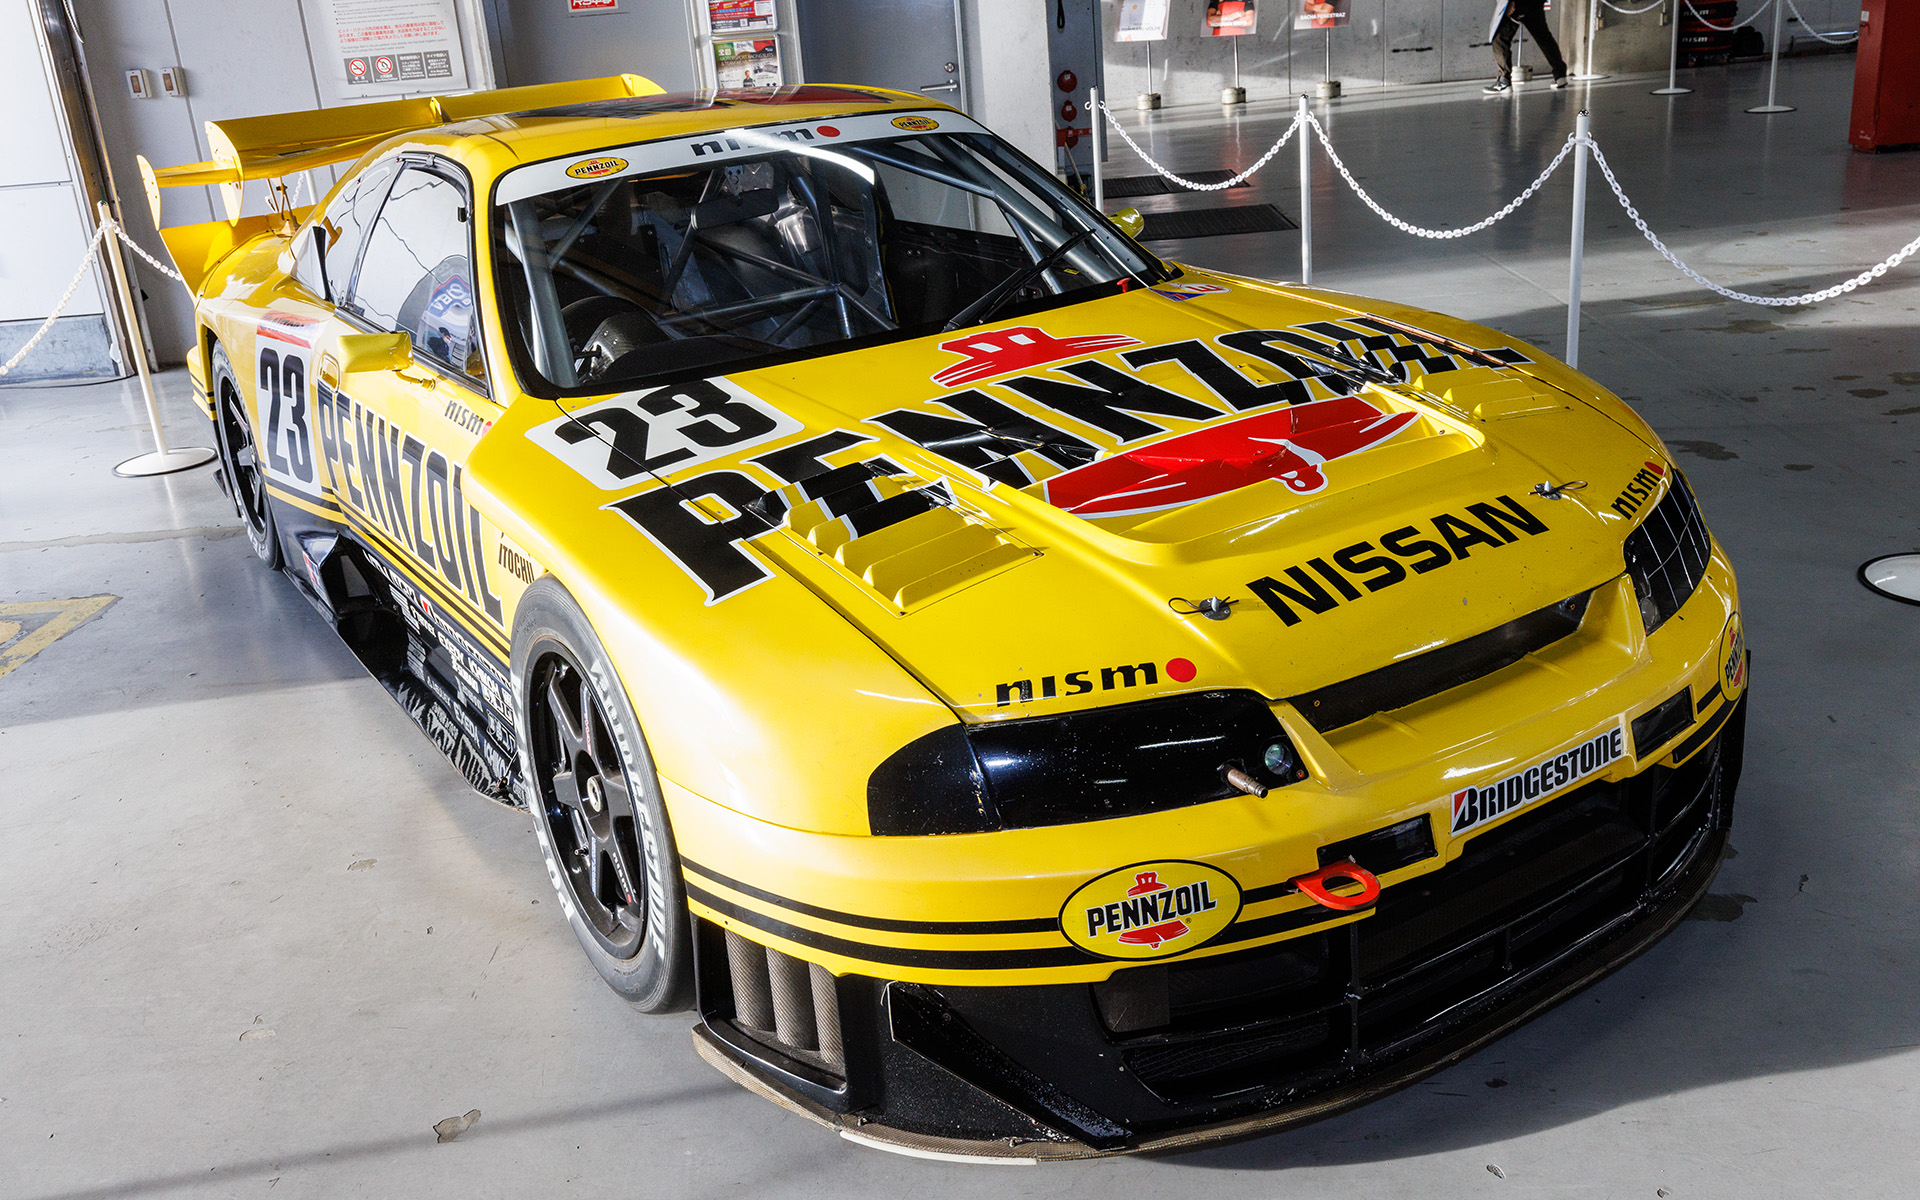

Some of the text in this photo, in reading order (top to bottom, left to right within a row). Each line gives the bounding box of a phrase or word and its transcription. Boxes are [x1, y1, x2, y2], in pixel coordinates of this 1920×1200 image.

[574, 158, 620, 177] PENNZOIL
[897, 117, 933, 129] PENNZOIL
[260, 347, 314, 484] 23
[553, 377, 779, 481] 23
[606, 313, 1532, 605] PENNZOIL
[317, 378, 506, 632] PENNZOIL
[1611, 461, 1667, 520] nismo
[1246, 494, 1549, 627] NISSAN
[995, 657, 1198, 708] nismo
[1452, 727, 1622, 833] BRIDGESTONE
[1085, 879, 1218, 938] PENNZOIL
